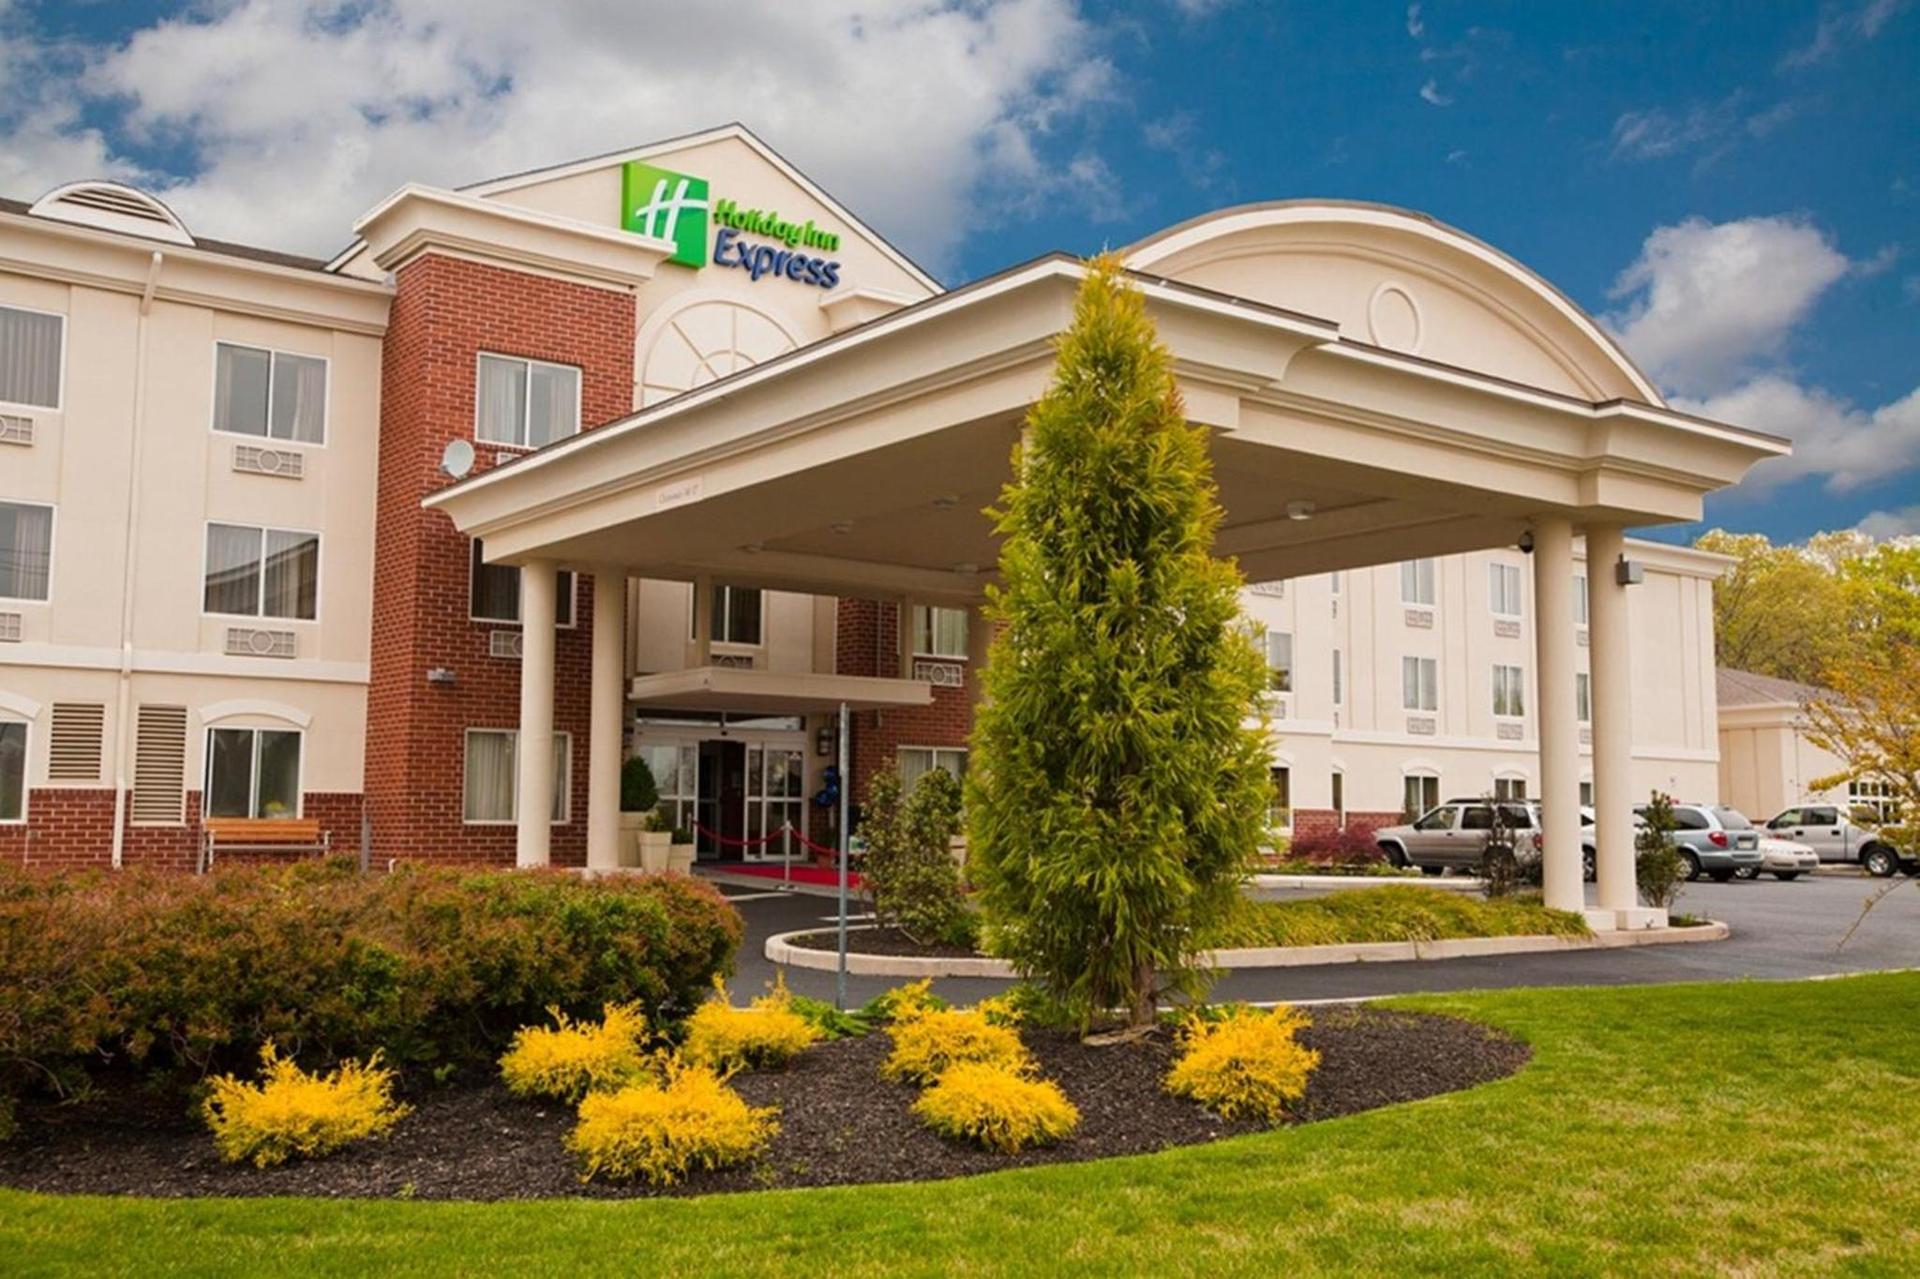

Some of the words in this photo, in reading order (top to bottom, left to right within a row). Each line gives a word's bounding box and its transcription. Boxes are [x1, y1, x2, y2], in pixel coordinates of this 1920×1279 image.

[713, 198, 803, 248] Holiday
[803, 220, 839, 251] Inn
[713, 228, 840, 288] Express
